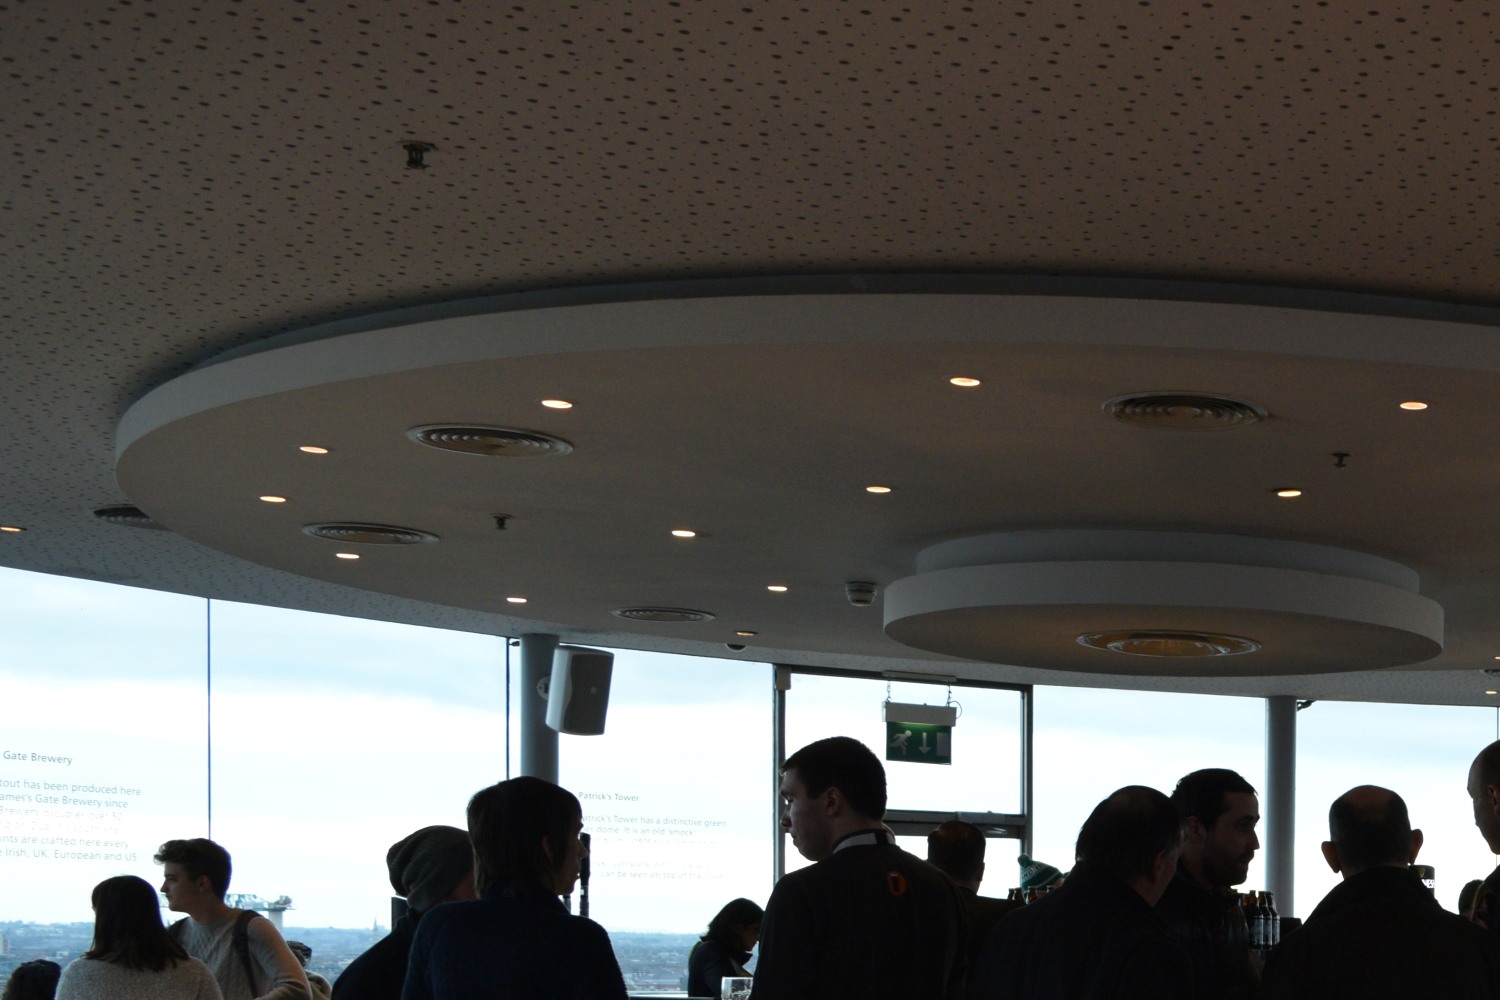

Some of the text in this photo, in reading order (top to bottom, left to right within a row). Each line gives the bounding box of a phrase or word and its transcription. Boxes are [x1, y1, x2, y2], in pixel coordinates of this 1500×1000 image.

[3, 750, 73, 766] Gate Brewery
[0, 779, 142, 796] tout has been produced here
[0, 793, 128, 809] ames's Gate Brewery since
[578, 791, 640, 802] Patrick's Tower
[582, 814, 612, 823] atrick's
[613, 815, 638, 824] Tower
[640, 816, 654, 825] has
[663, 817, 702, 826] distinctive
[704, 819, 727, 828] green
[21, 836, 38, 844] are
[54, 849, 101, 861] European
[104, 851, 122, 861] and
[125, 852, 138, 862] US
